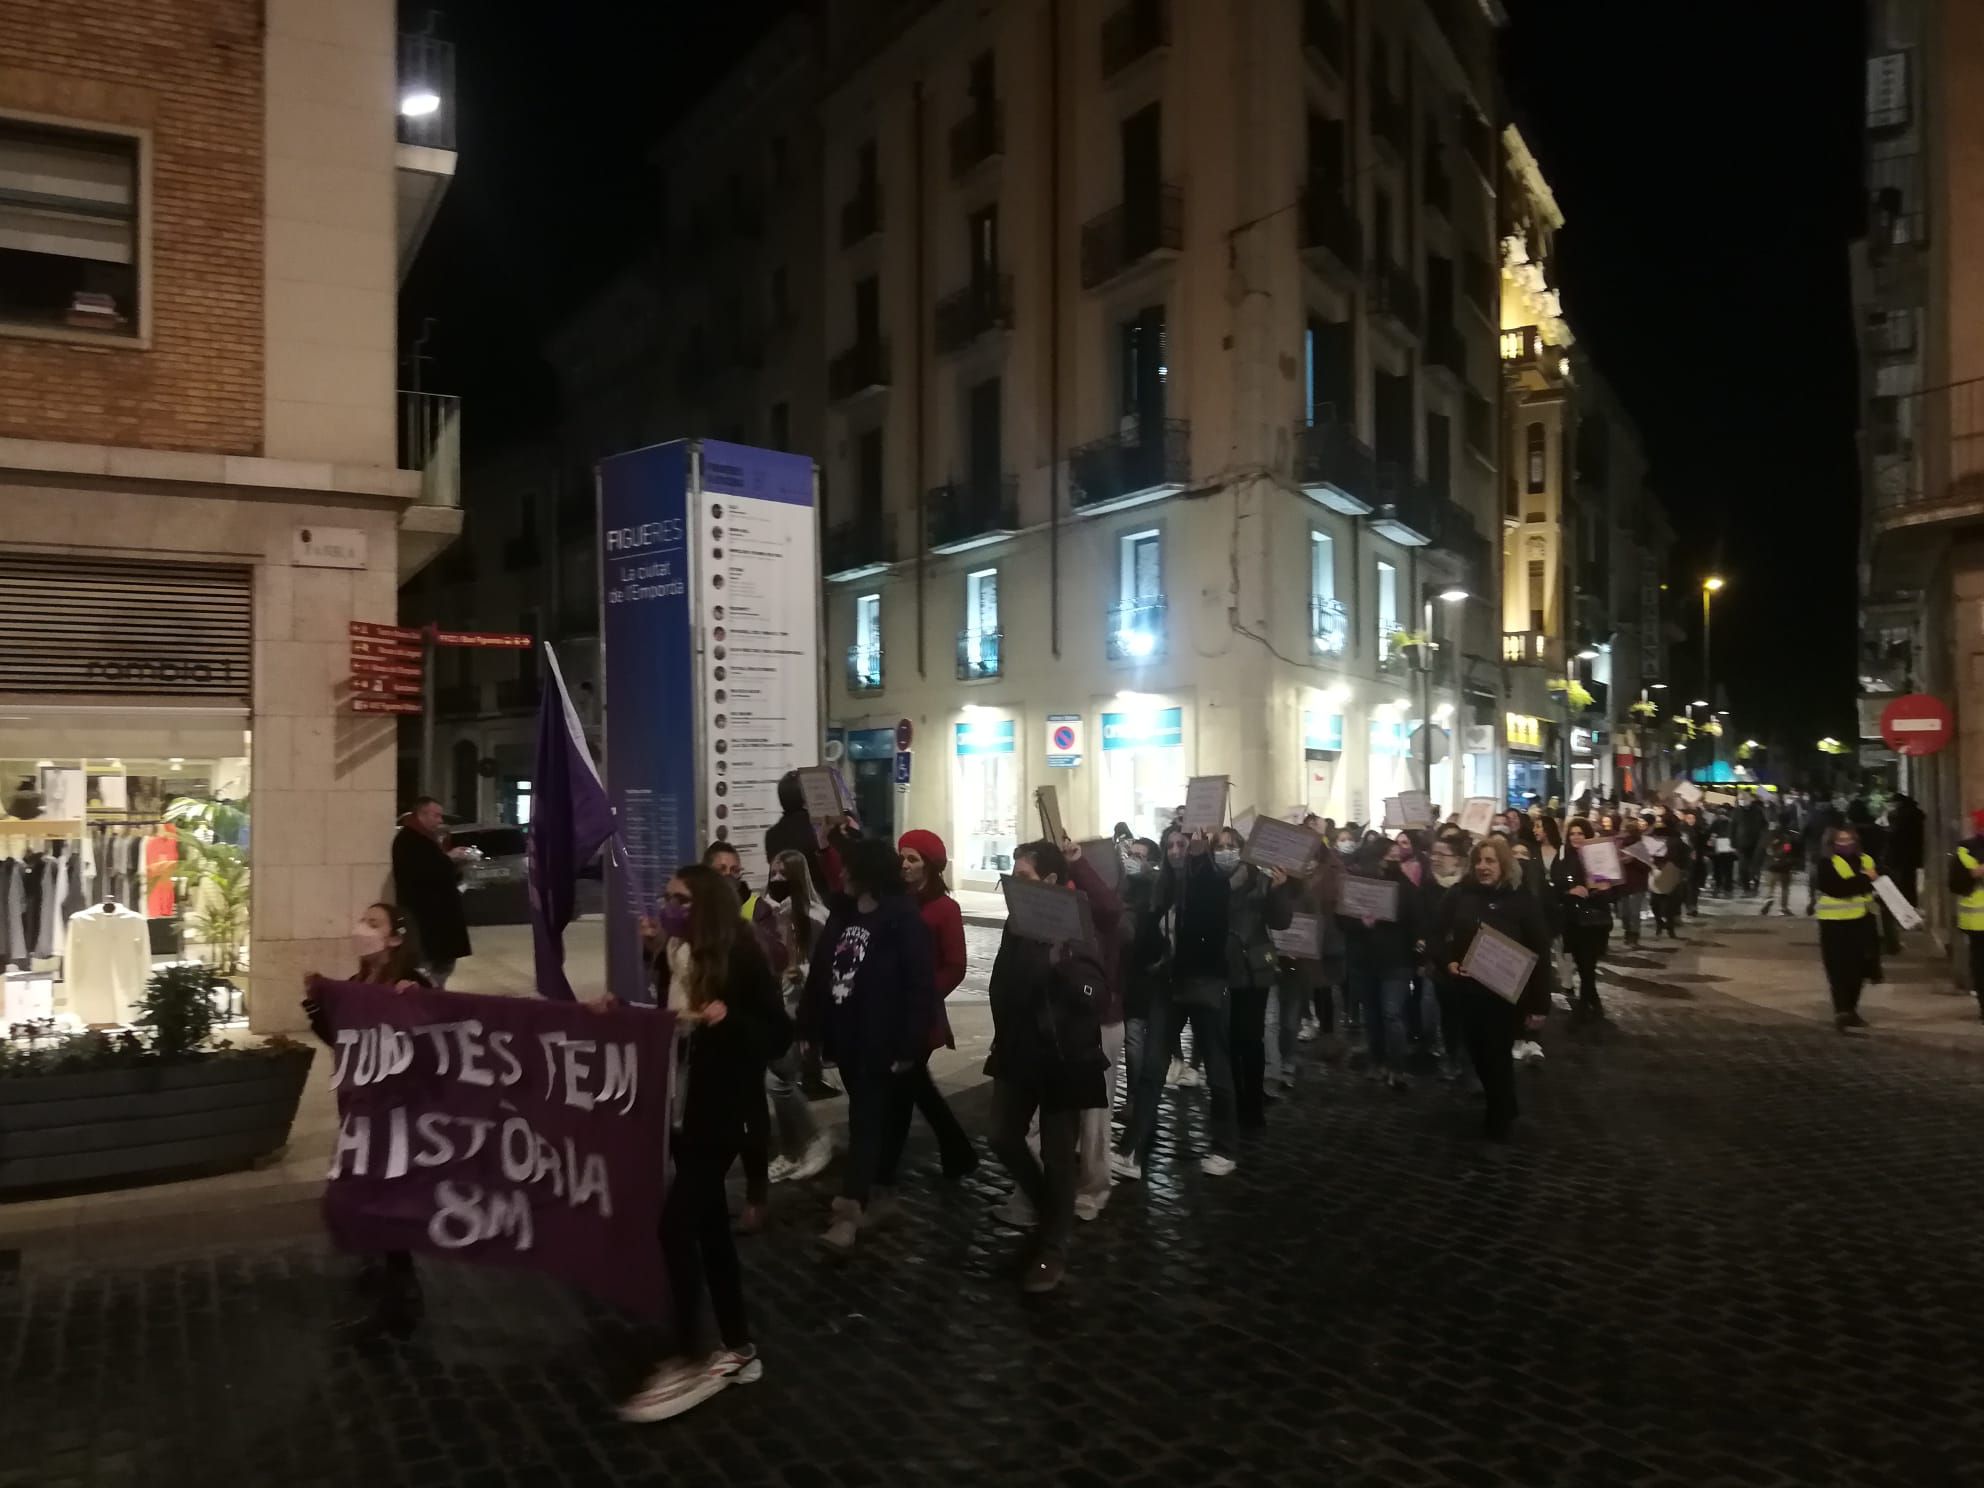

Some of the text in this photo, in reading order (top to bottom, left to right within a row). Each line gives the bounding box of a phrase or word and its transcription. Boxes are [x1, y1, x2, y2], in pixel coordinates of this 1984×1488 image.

[606, 518, 683, 551] FIGUERES
[620, 562, 671, 582] La ciutat
[427, 1180, 534, 1250] 8M
